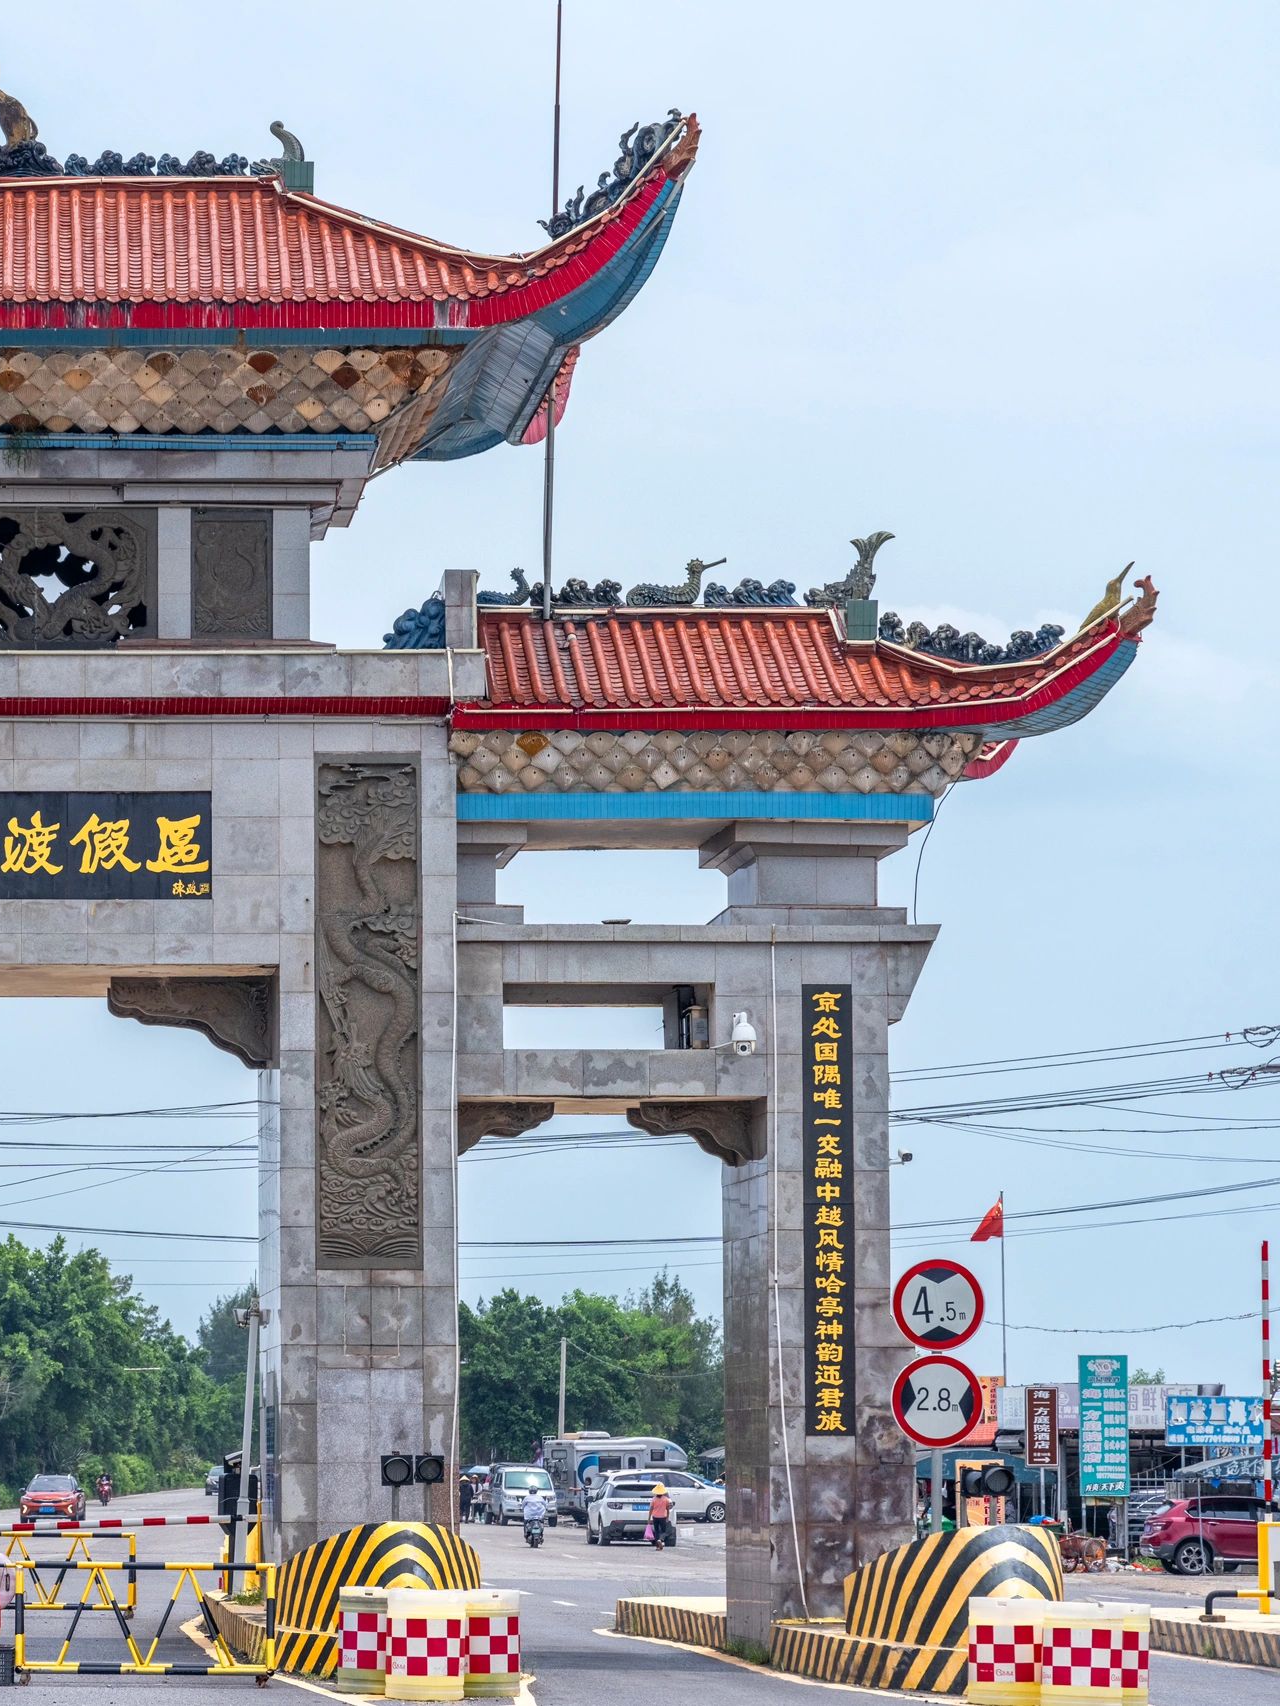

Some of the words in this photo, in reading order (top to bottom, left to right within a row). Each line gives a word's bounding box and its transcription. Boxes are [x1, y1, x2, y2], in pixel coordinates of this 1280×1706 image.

[912, 1286, 967, 1324] 4.5m
[916, 1387, 959, 1412] 2.8m
[1033, 1390, 1051, 1450] 海一方庭院酒店
